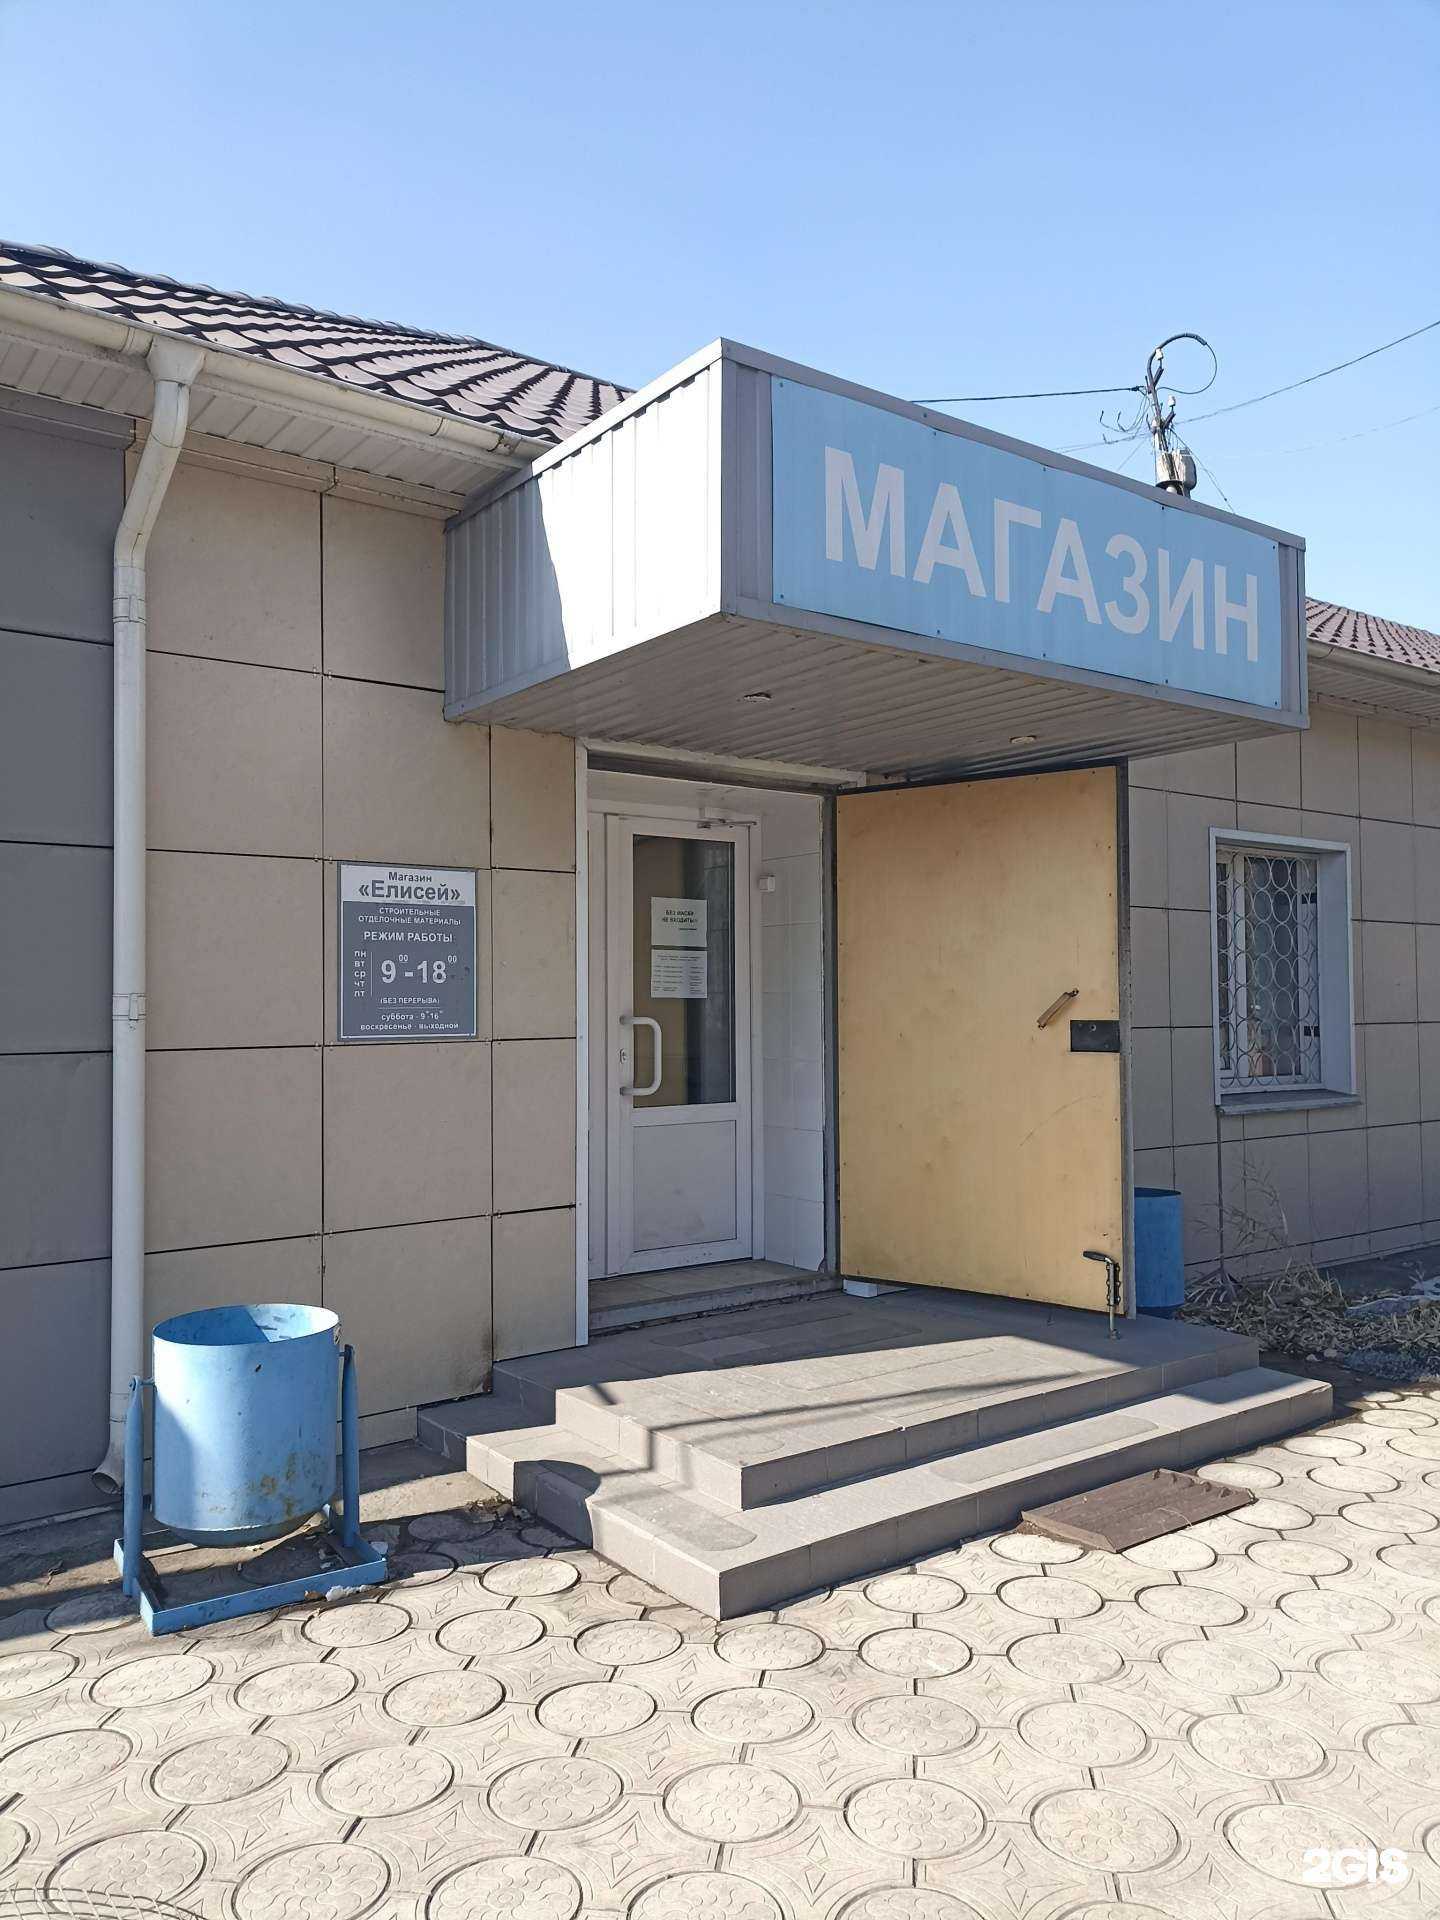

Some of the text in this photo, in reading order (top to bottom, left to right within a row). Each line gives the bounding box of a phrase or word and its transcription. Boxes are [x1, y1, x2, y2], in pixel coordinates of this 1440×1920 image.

[825, 446, 1258, 662] МАГАЗИН
[388, 871, 432, 883] Магазин
[358, 879, 461, 901] «Елисей»
[379, 907, 441, 916] СТРОИТЕЛЬНЫЕ
[358, 915, 461, 926] ОТДЕЛОЧНЫЕ МАТЕРИАЛЫ
[363, 931, 453, 943] РЕЖИМ РАБОТЫ
[381, 1012, 414, 1021] суббота
